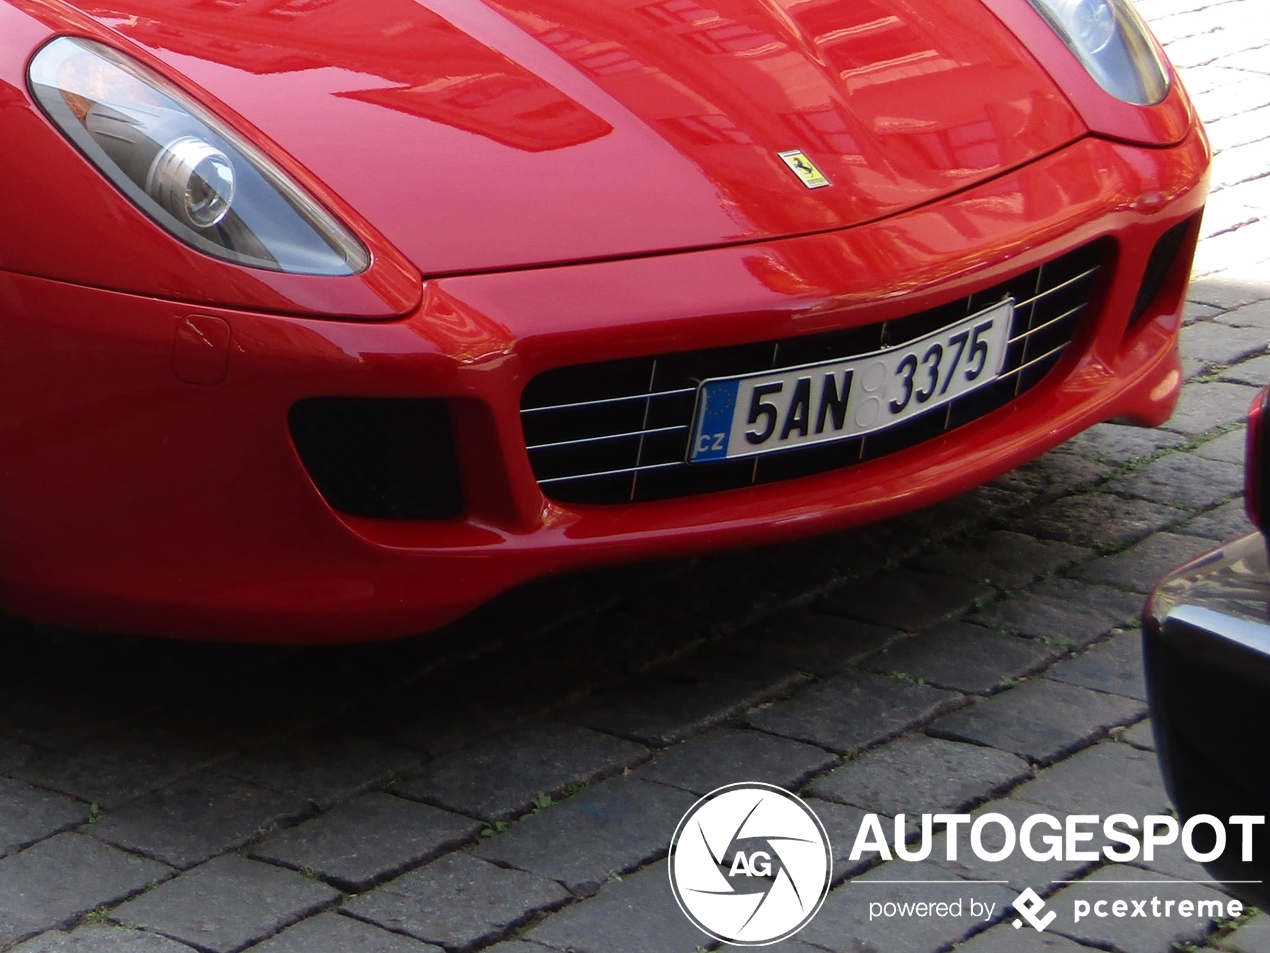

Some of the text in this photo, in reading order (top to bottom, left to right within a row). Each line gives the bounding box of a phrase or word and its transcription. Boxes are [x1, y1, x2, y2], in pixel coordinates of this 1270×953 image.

[745, 317, 994, 446] 5AN 3375
[698, 432, 724, 453] CZ
